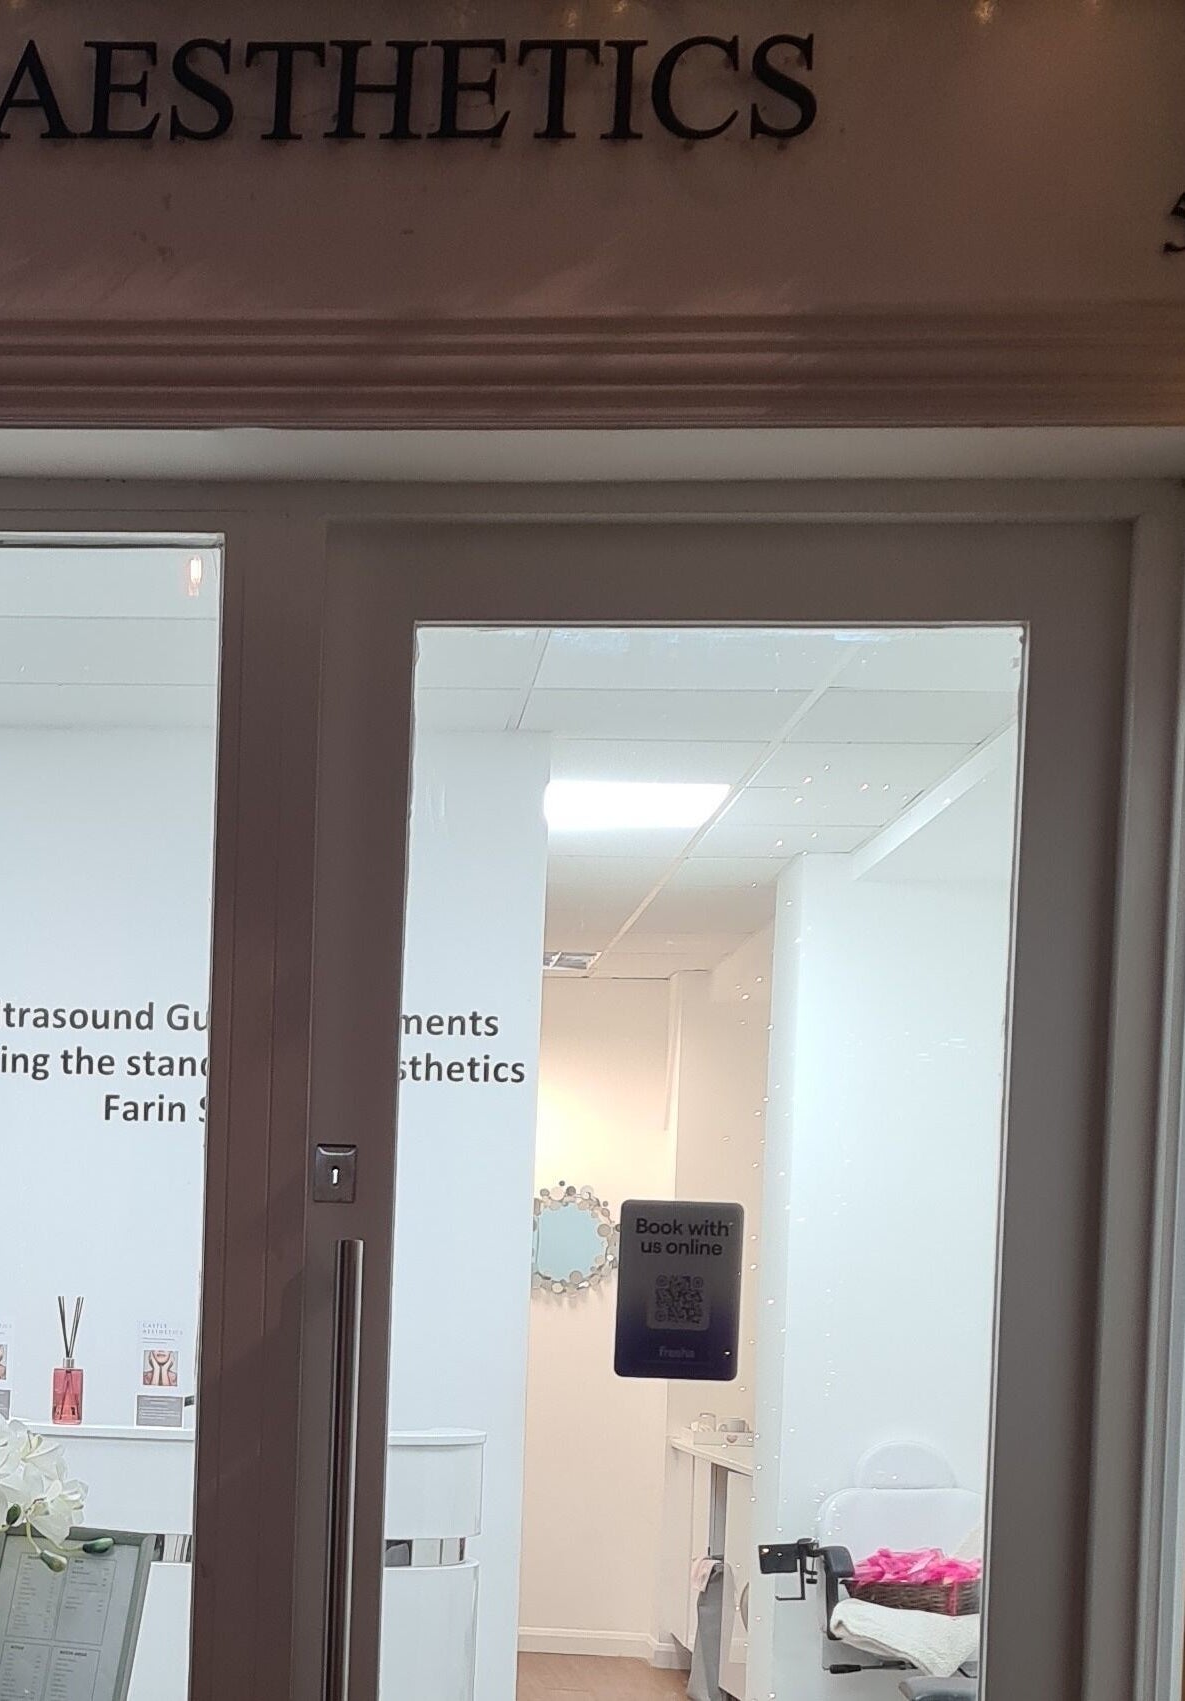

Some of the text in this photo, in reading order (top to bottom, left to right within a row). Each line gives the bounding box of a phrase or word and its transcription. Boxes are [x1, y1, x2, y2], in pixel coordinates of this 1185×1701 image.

[61, 1047, 115, 1077] the
[103, 1093, 187, 1123] Farin
[635, 1218, 730, 1237] Book with
[640, 1239, 723, 1257] us online
